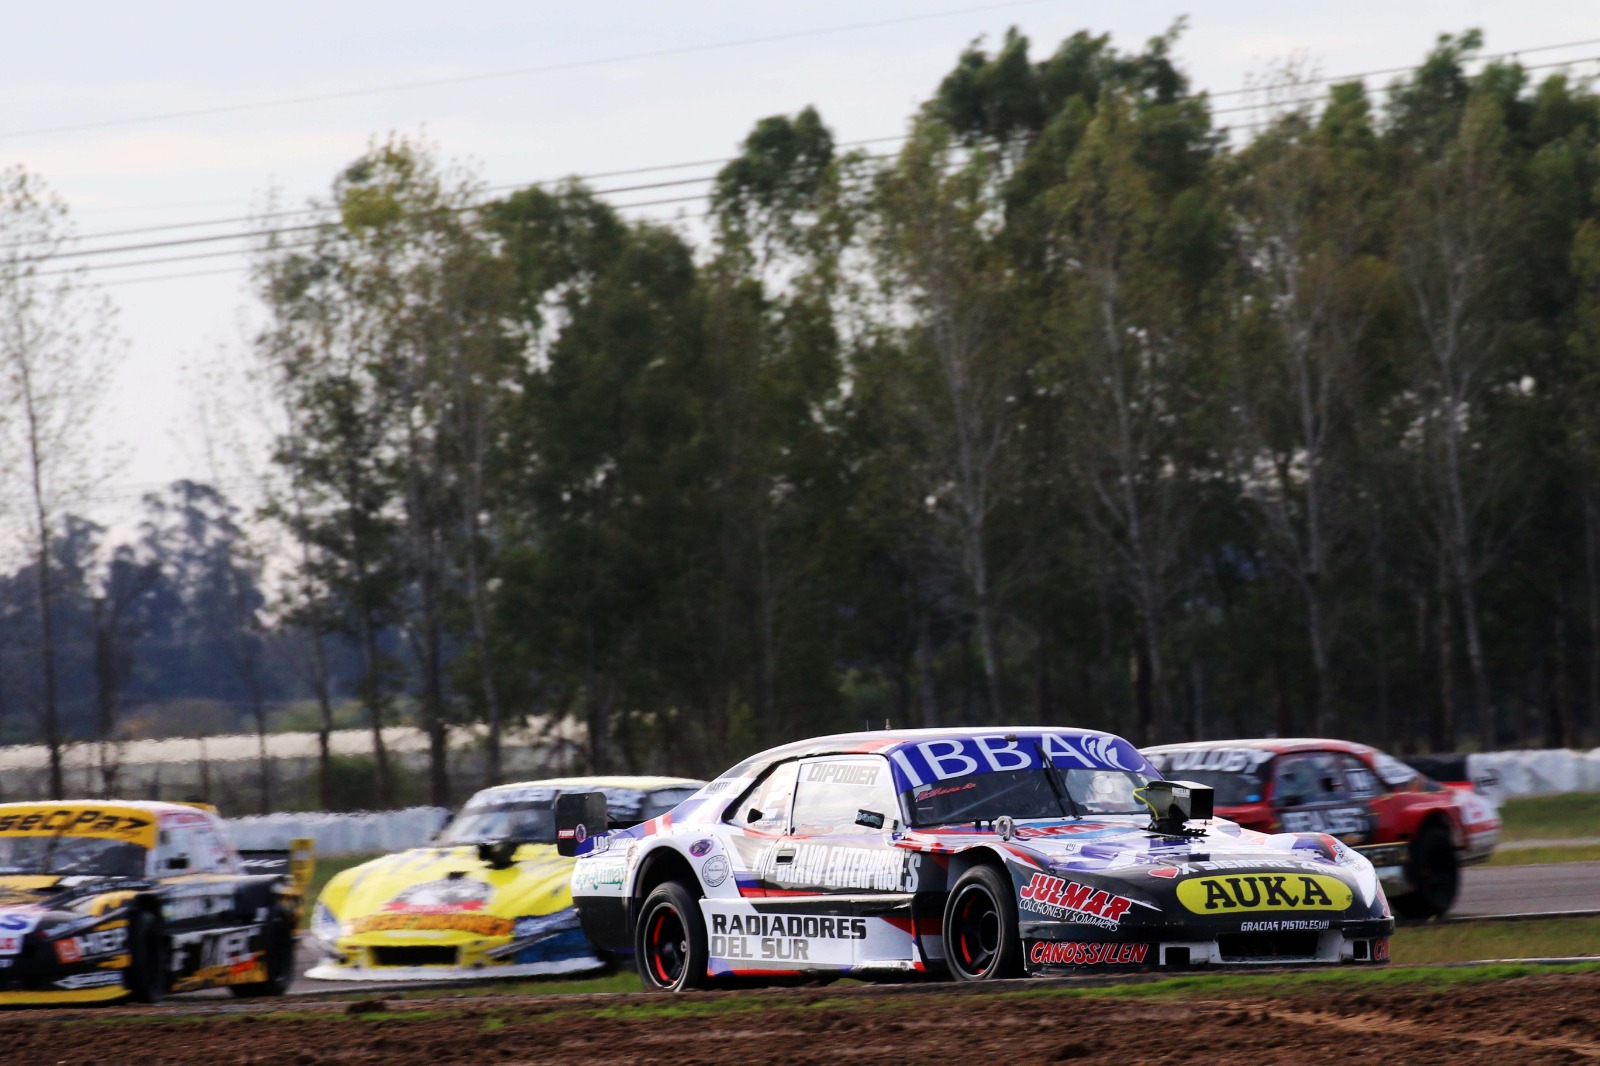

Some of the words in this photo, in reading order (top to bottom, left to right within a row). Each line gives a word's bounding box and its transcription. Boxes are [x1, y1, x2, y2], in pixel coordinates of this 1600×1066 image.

[891, 733, 1096, 788] IBBA
[807, 764, 881, 785] DIPOWER
[825, 846, 922, 893] ENTERPRISES
[1197, 859, 1296, 871] SIEMPRE
[1020, 872, 1131, 923] JULMAR
[1201, 876, 1332, 910] AUKA
[1019, 899, 1064, 919] COLCHONES
[1065, 910, 1073, 920] Y
[712, 913, 866, 940] RADIADORES
[1241, 921, 1279, 931] GRACIAS
[712, 936, 752, 959] DEL
[761, 937, 809, 960] SUR
[1031, 941, 1149, 965] CAÑOSSILEN
